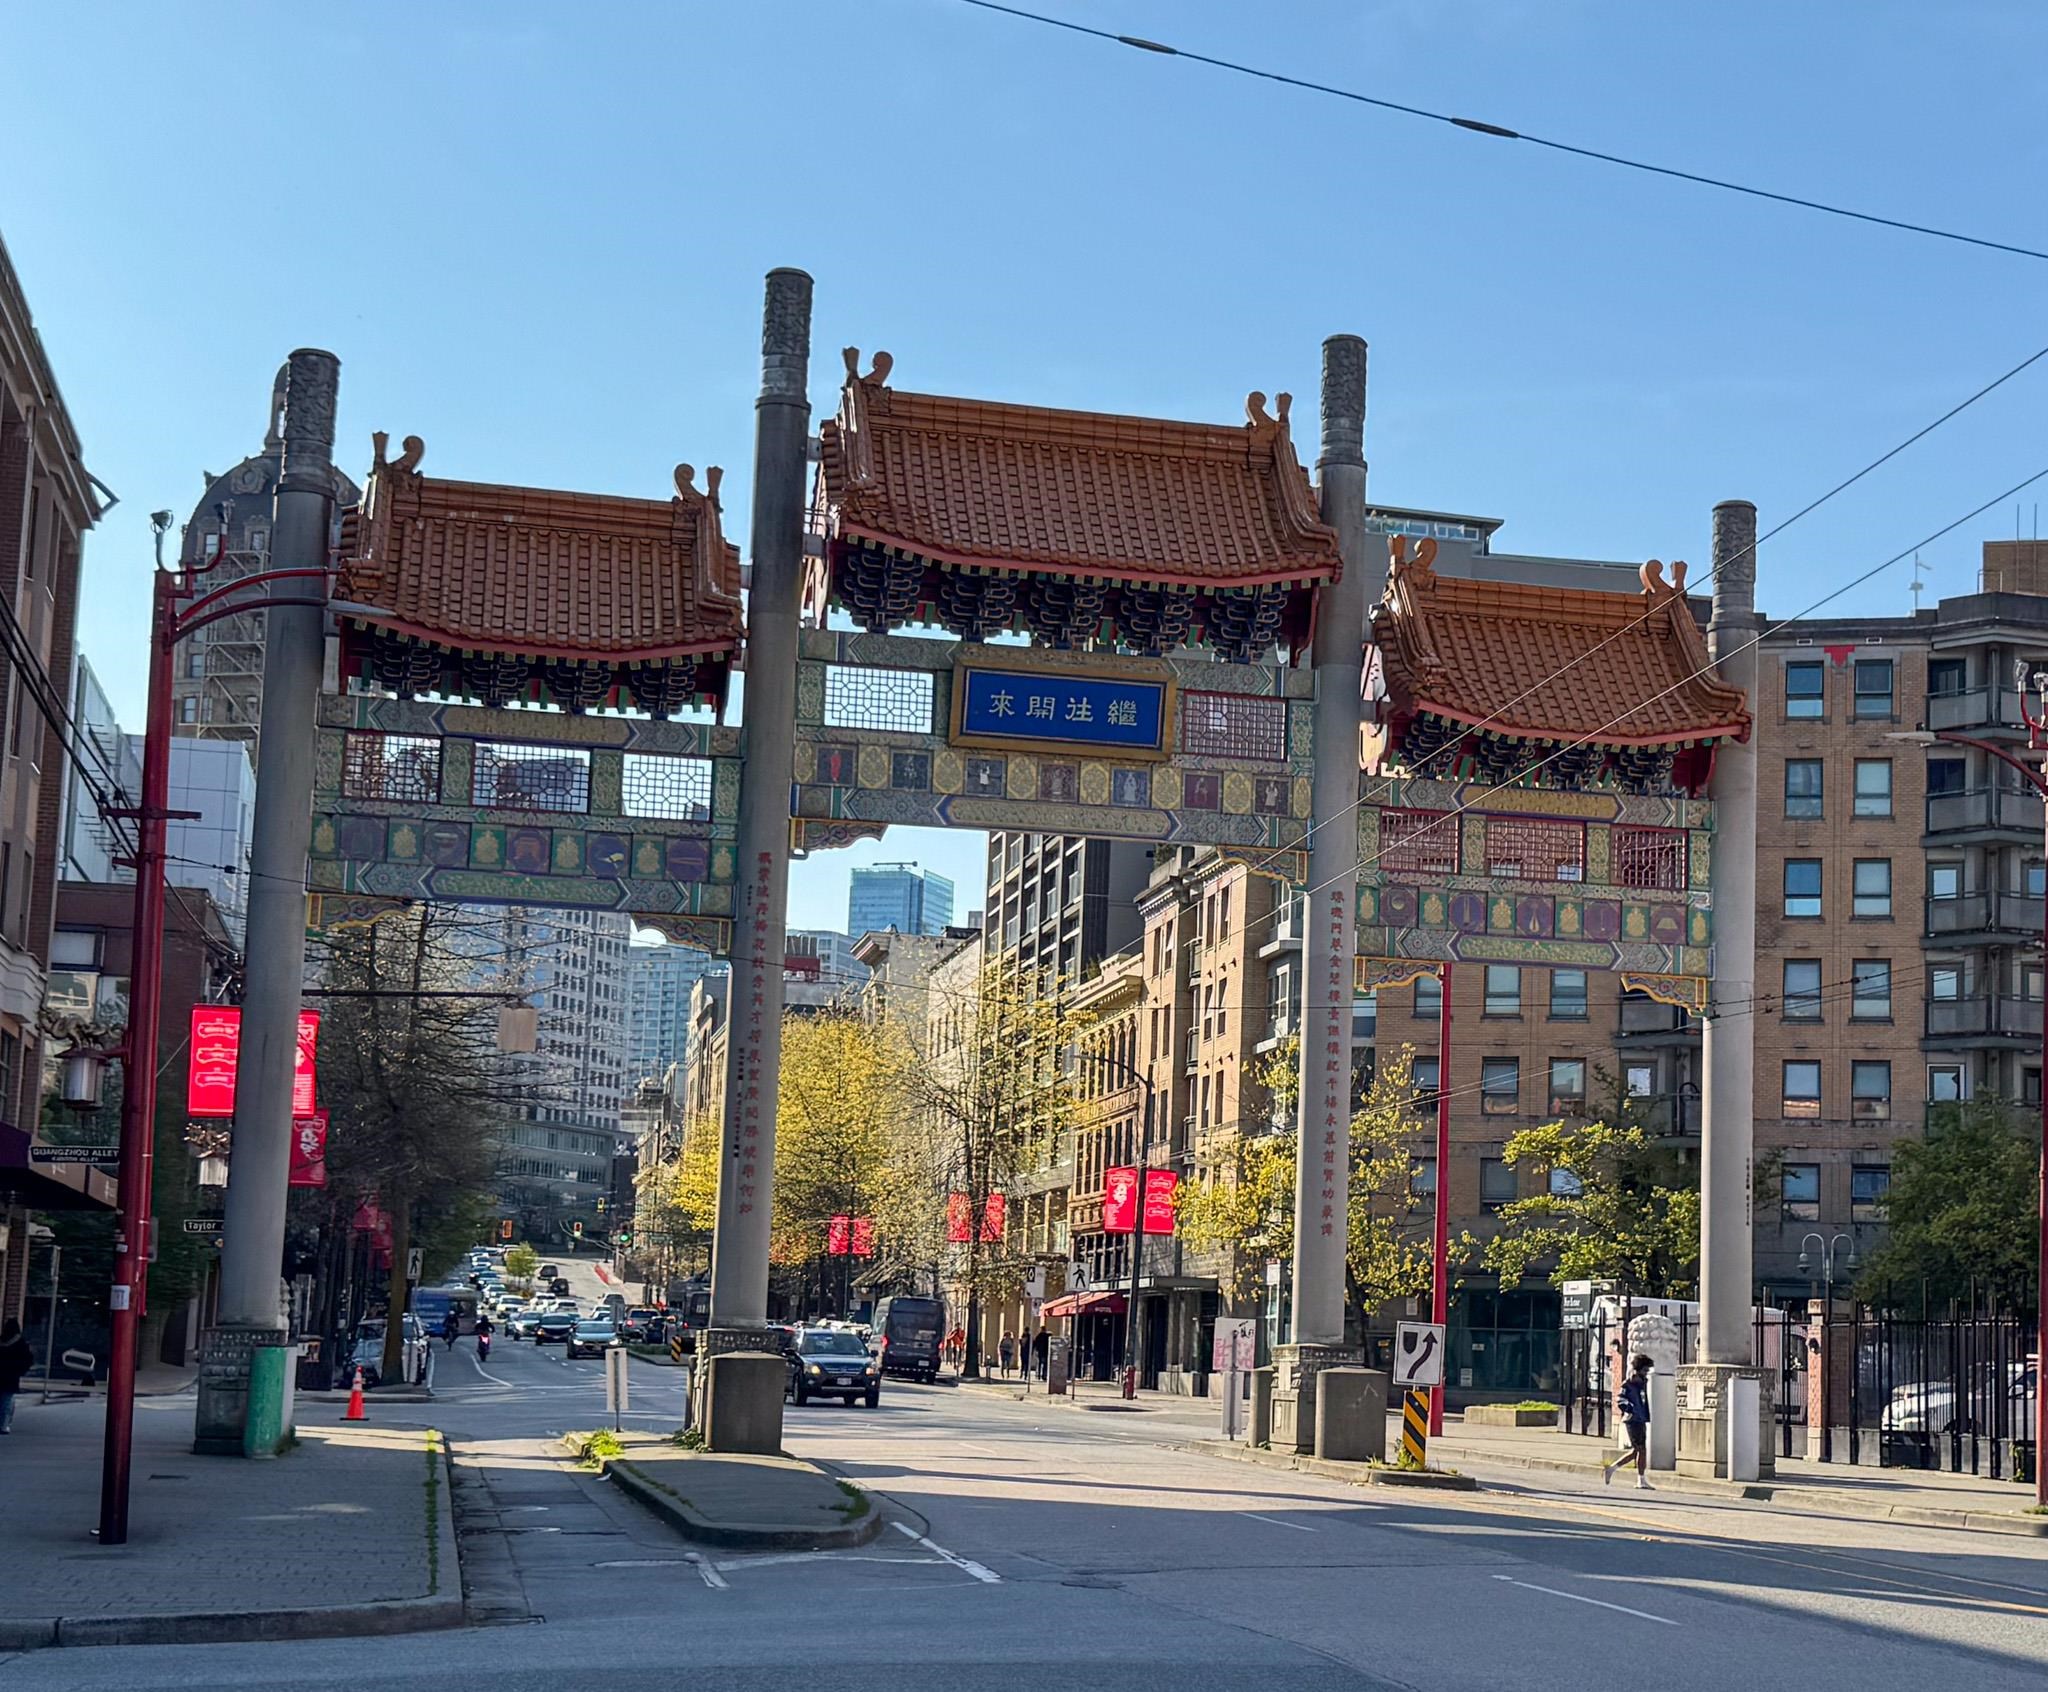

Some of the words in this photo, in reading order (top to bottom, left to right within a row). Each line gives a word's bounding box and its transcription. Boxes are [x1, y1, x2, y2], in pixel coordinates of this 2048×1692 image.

[32, 1148, 89, 1157] GUANGZHOU
[92, 1149, 119, 1157] ALLEY
[188, 1221, 217, 1232] Taylor
